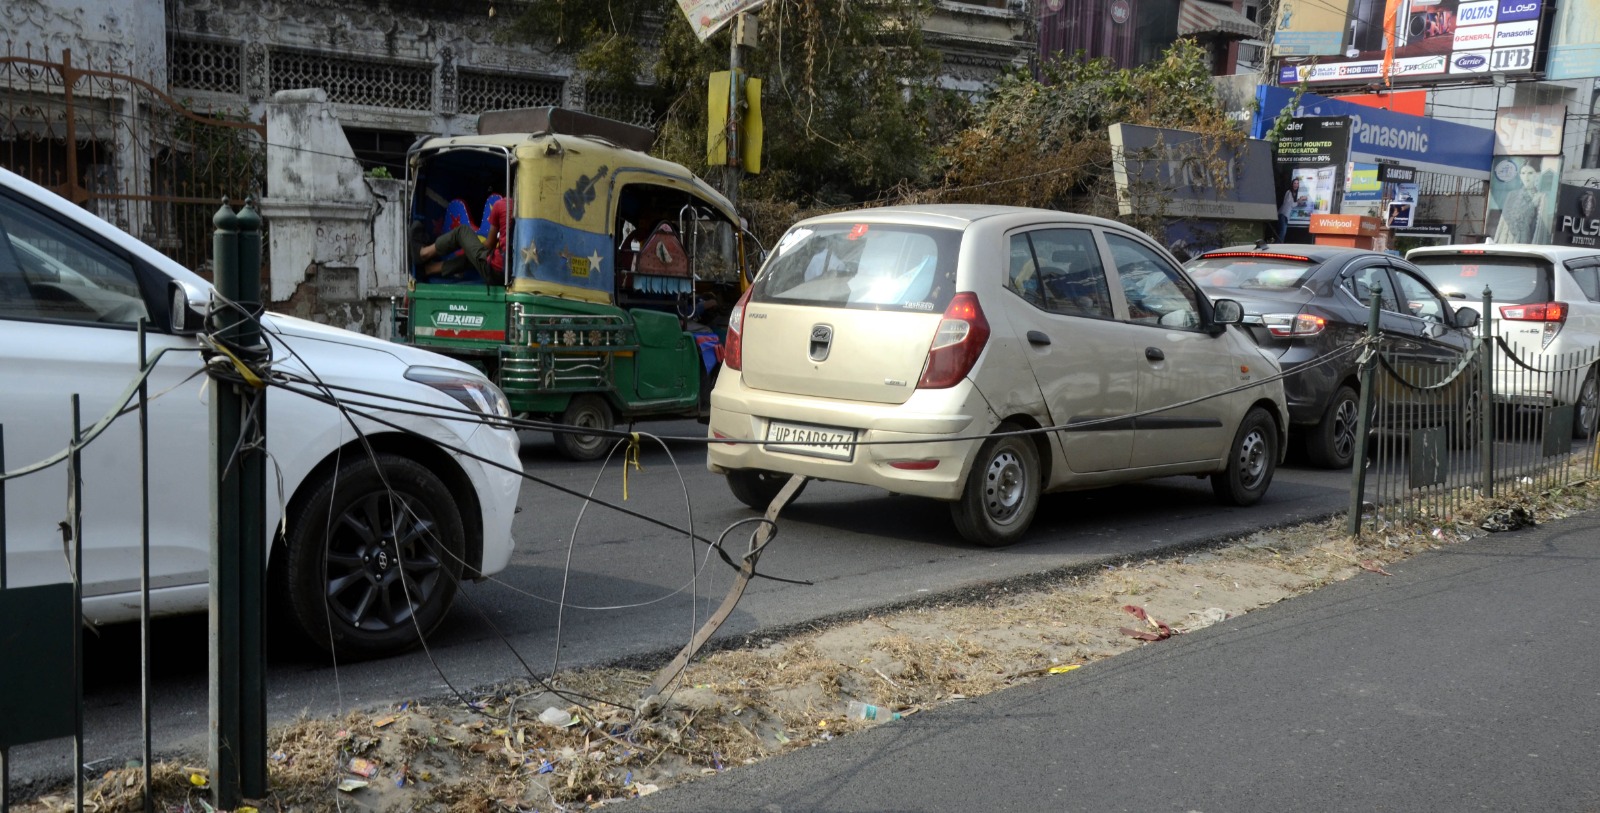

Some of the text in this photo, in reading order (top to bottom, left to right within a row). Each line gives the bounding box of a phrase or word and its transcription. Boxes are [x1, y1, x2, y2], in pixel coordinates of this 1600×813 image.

[1460, 5, 1494, 21] VOLTAS
[1502, 3, 1537, 14] LLOYD
[1496, 28, 1535, 39] Panasonic
[1458, 57, 1483, 66] Carrier
[1493, 48, 1530, 69] IFB
[1346, 64, 1362, 74] HDB
[1349, 114, 1428, 153] Panasonic
[1386, 167, 1413, 180] SAMSUNG
[1319, 219, 1352, 229] Whirlpool
[1561, 215, 1600, 236] PULS
[437, 312, 484, 326] Maxima
[775, 426, 853, 452] UP16AD9474
